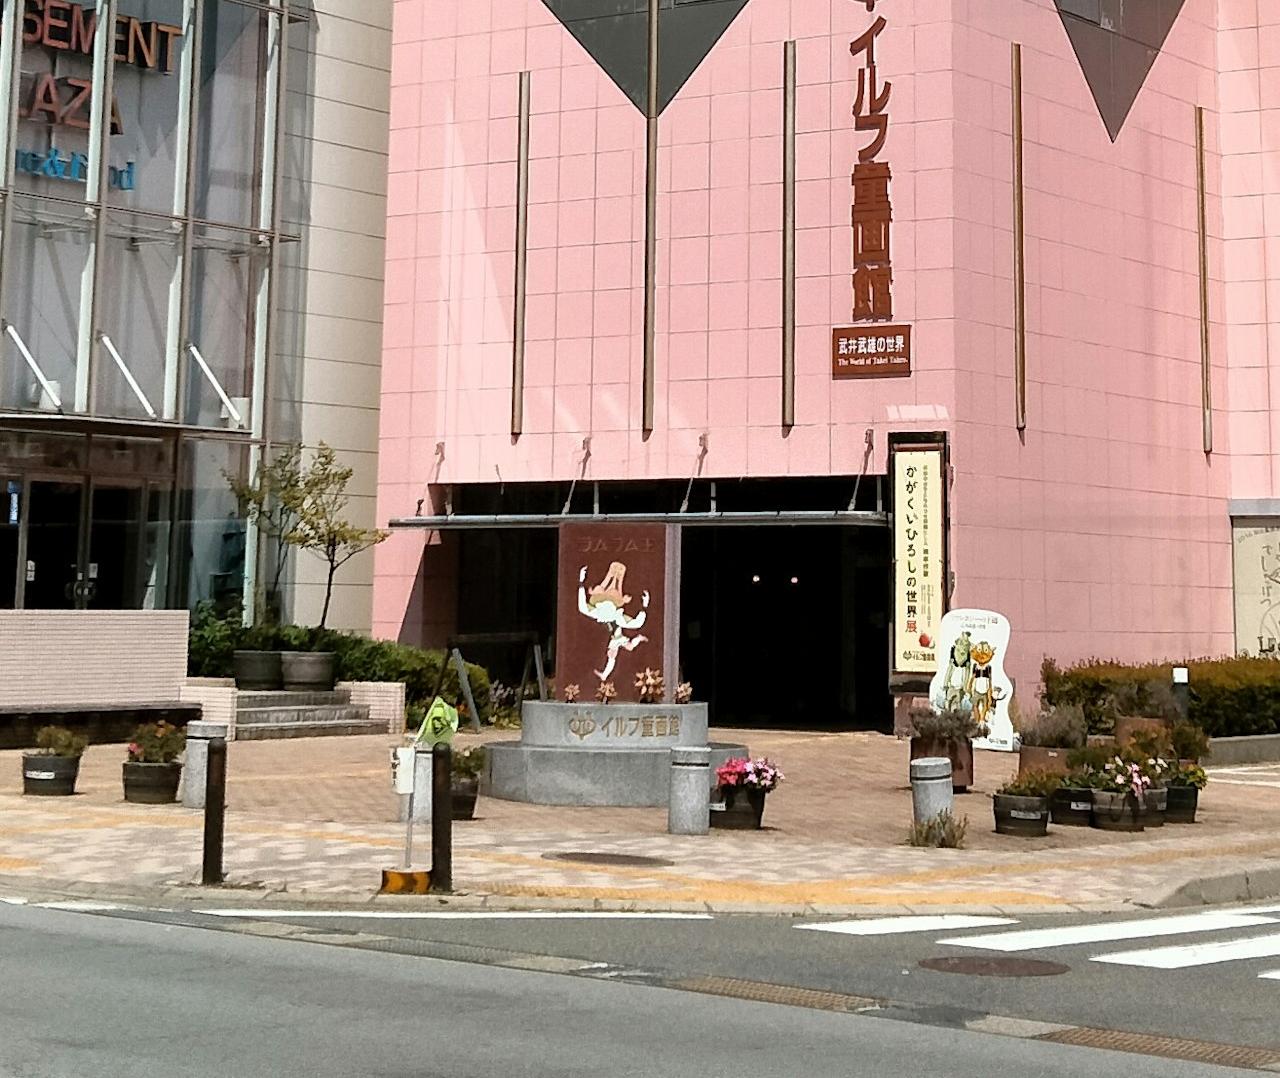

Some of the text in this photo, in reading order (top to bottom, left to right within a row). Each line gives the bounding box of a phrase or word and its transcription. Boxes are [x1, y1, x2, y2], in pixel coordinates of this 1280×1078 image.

[850, 16, 893, 322] イルフ童画館
[838, 335, 904, 355] 武井武雄の世界
[905, 465, 918, 633] かがくいひろしの世界展
[601, 715, 681, 739] イルフ童画館
